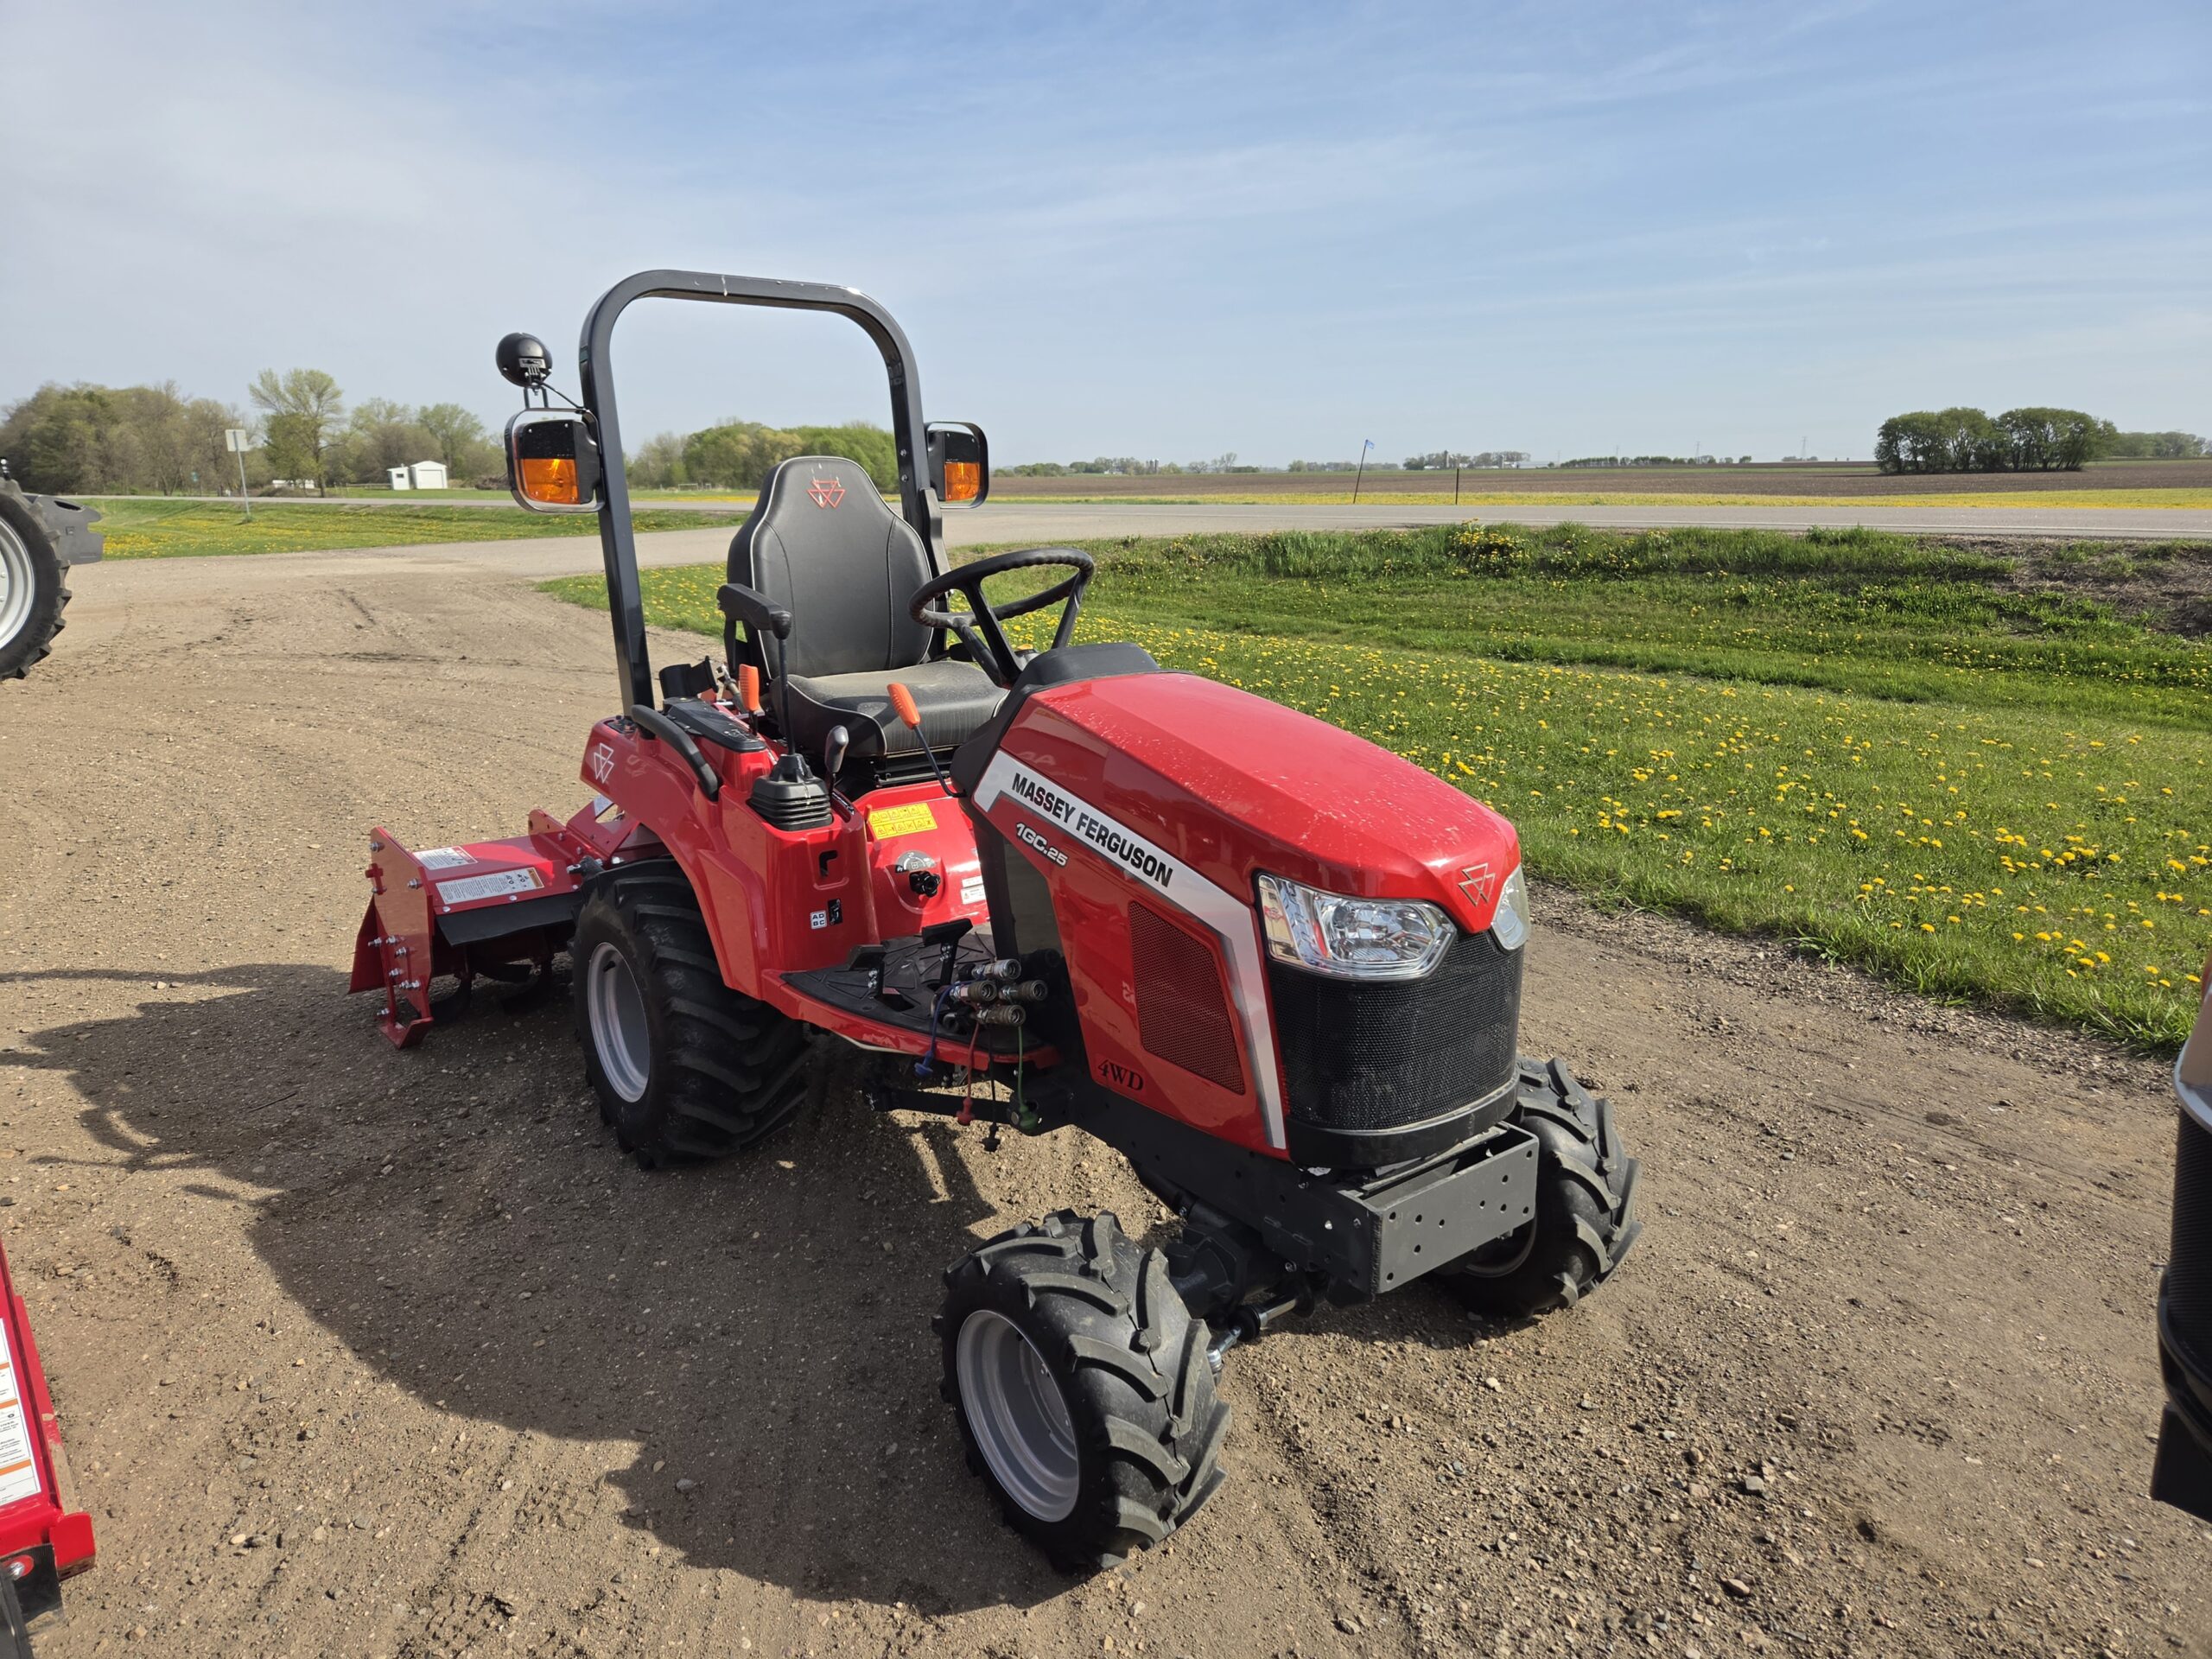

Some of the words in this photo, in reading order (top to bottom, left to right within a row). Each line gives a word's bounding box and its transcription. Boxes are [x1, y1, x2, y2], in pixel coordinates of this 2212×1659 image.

[1012, 772, 1076, 823] MASSEY
[1076, 812, 1173, 887] FERGUSON
[1016, 823, 1069, 867] 1GC.25
[1097, 1058, 1144, 1091] 4WD
